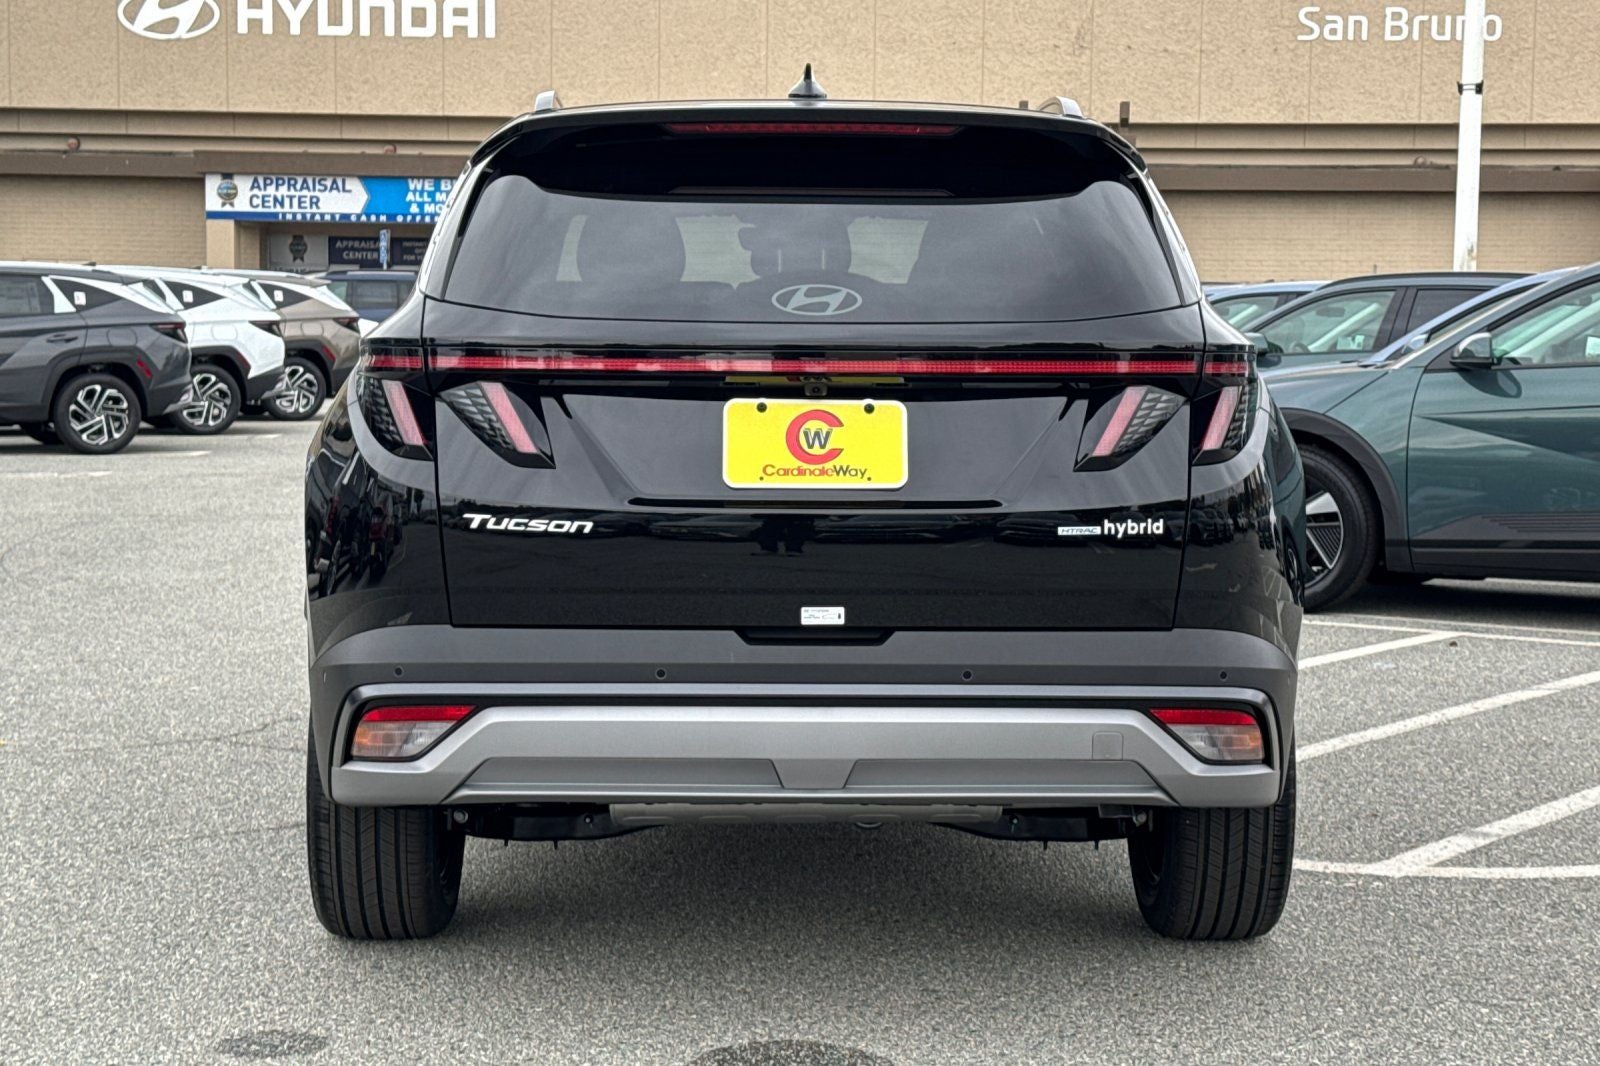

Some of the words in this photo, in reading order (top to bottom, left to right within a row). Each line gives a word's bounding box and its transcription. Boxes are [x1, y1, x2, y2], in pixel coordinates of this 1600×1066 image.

[237, 0, 496, 38] HYUNDAI
[1297, 6, 1368, 41] San
[249, 176, 352, 193] APPRAISAL
[408, 178, 435, 191] WE
[249, 194, 321, 209] CENTER
[405, 191, 432, 202] ALL
[410, 202, 420, 213] &
[762, 464, 868, 479] CardinaleWay
[1060, 527, 1099, 535] HTRAC
[1103, 518, 1164, 539] hybrid
